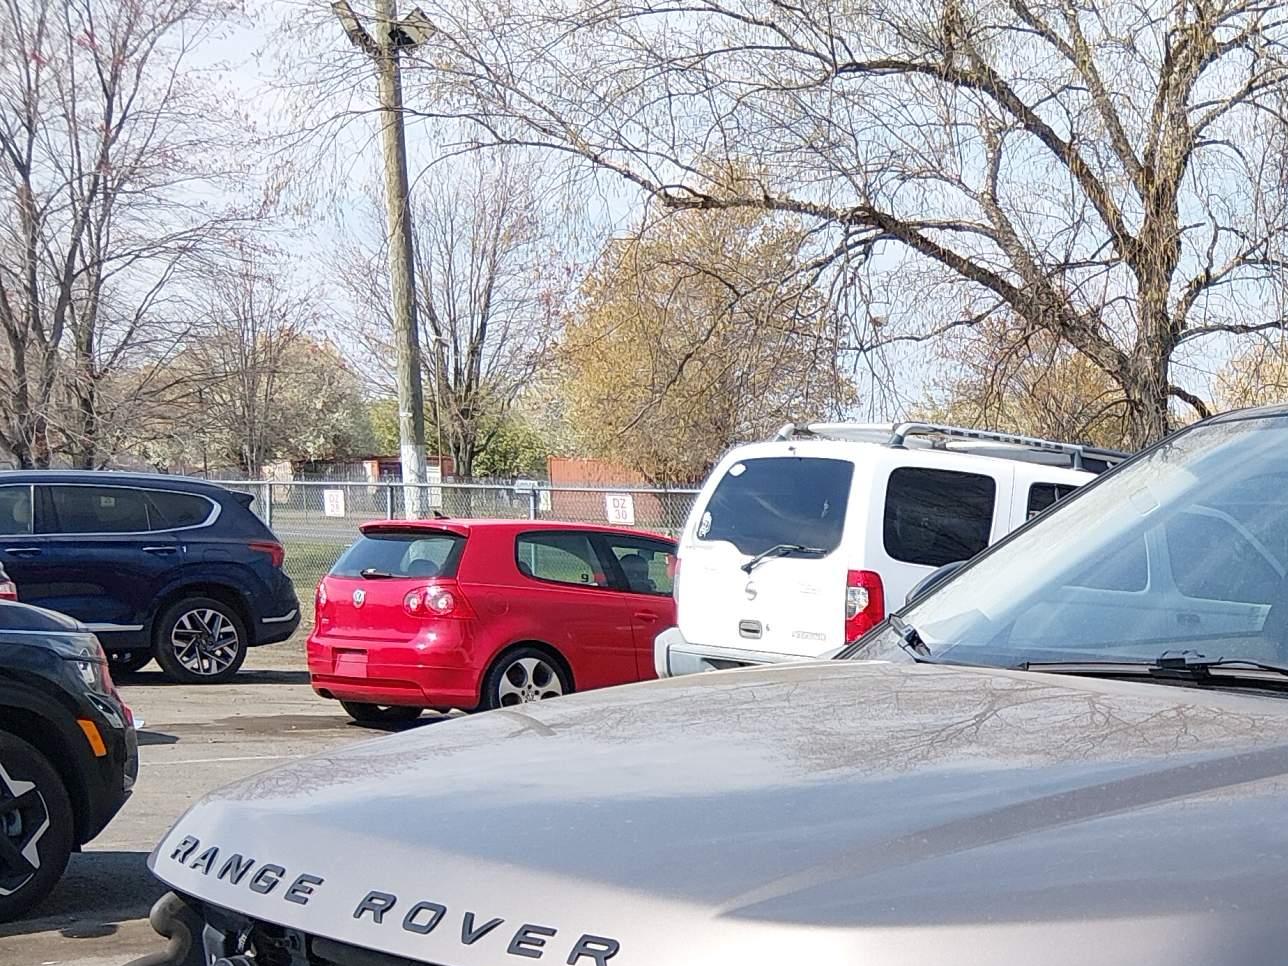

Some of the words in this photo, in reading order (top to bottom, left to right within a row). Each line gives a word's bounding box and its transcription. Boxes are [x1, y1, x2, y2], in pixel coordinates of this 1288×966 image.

[612, 498, 626, 508] DZ
[615, 509, 627, 520] 30
[170, 835, 324, 905] RANGE
